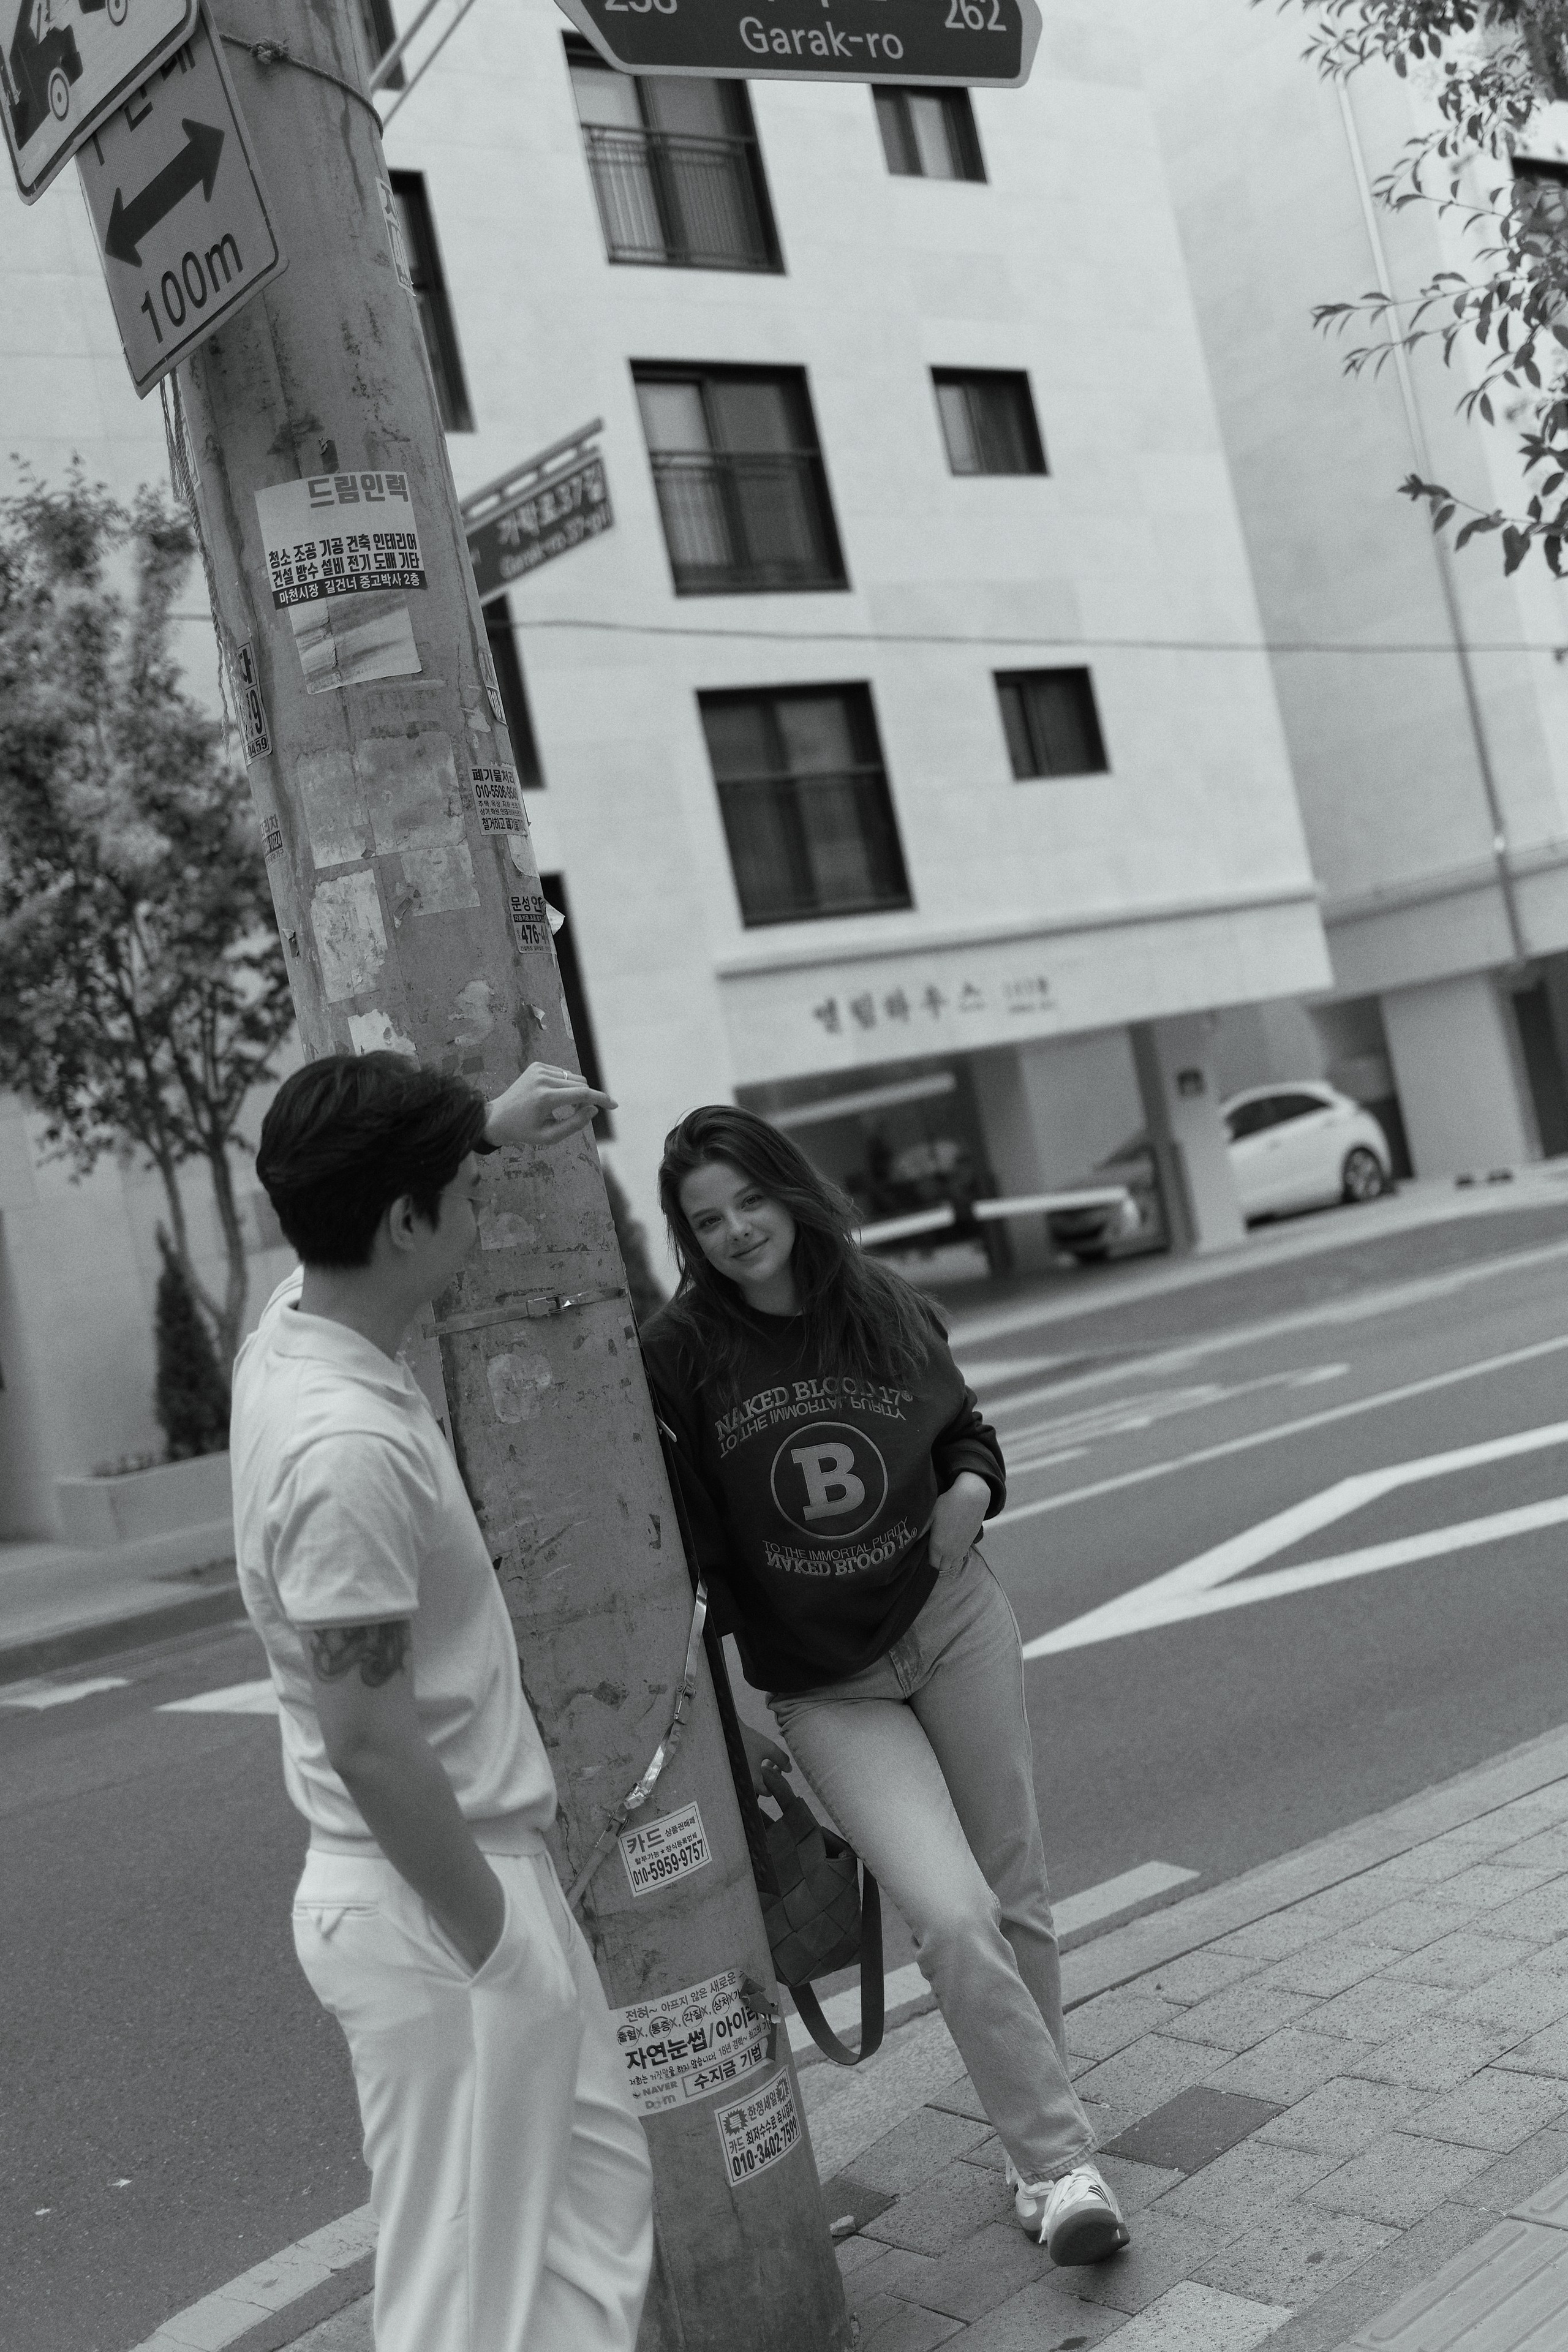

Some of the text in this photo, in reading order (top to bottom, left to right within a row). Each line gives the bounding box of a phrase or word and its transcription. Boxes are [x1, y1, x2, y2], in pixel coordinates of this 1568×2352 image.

[944, 0, 1007, 31] 262
[739, 17, 904, 59] Garak-ro
[140, 233, 244, 344] 100m
[307, 474, 409, 508] 드림인력
[268, 533, 418, 570] 청소 조공 기공 건축 인테리어
[272, 552, 420, 589] 건설 방수 설비 전기 도배 기타
[279, 573, 420, 605] 마천시장 길건너 중고박사 2층
[247, 737, 268, 757] 0459
[472, 768, 516, 785] 폐기물처리
[481, 817, 505, 831] 철거하고
[714, 1386, 790, 1441] NAKED
[790, 1442, 865, 1521] B
[762, 1516, 908, 1561] TO THE IMMORTAL PURITY
[627, 1815, 696, 1855] 카드 상품권매매
[635, 1831, 698, 1865] 할부가능 정식등록업체
[633, 1838, 704, 1885] 010-5959-9757
[662, 1995, 688, 2011] 아프지
[690, 1988, 707, 2003] 않은
[710, 1972, 736, 1993] 새로운
[629, 2074, 648, 2086] 저희는
[650, 2065, 675, 2080] 거짓말을
[677, 2064, 690, 2073] 하지
[718, 2041, 732, 2056] 18년
[748, 2023, 762, 2040] 최고의
[694, 2043, 763, 2090] 수지금 기법
[643, 2081, 678, 2096] NAVER
[747, 2089, 778, 2122] 한정세일
[729, 2136, 745, 2155] 카드
[745, 2114, 777, 2146] 최저수수료
[732, 2115, 798, 2177] 010-3402-7599
